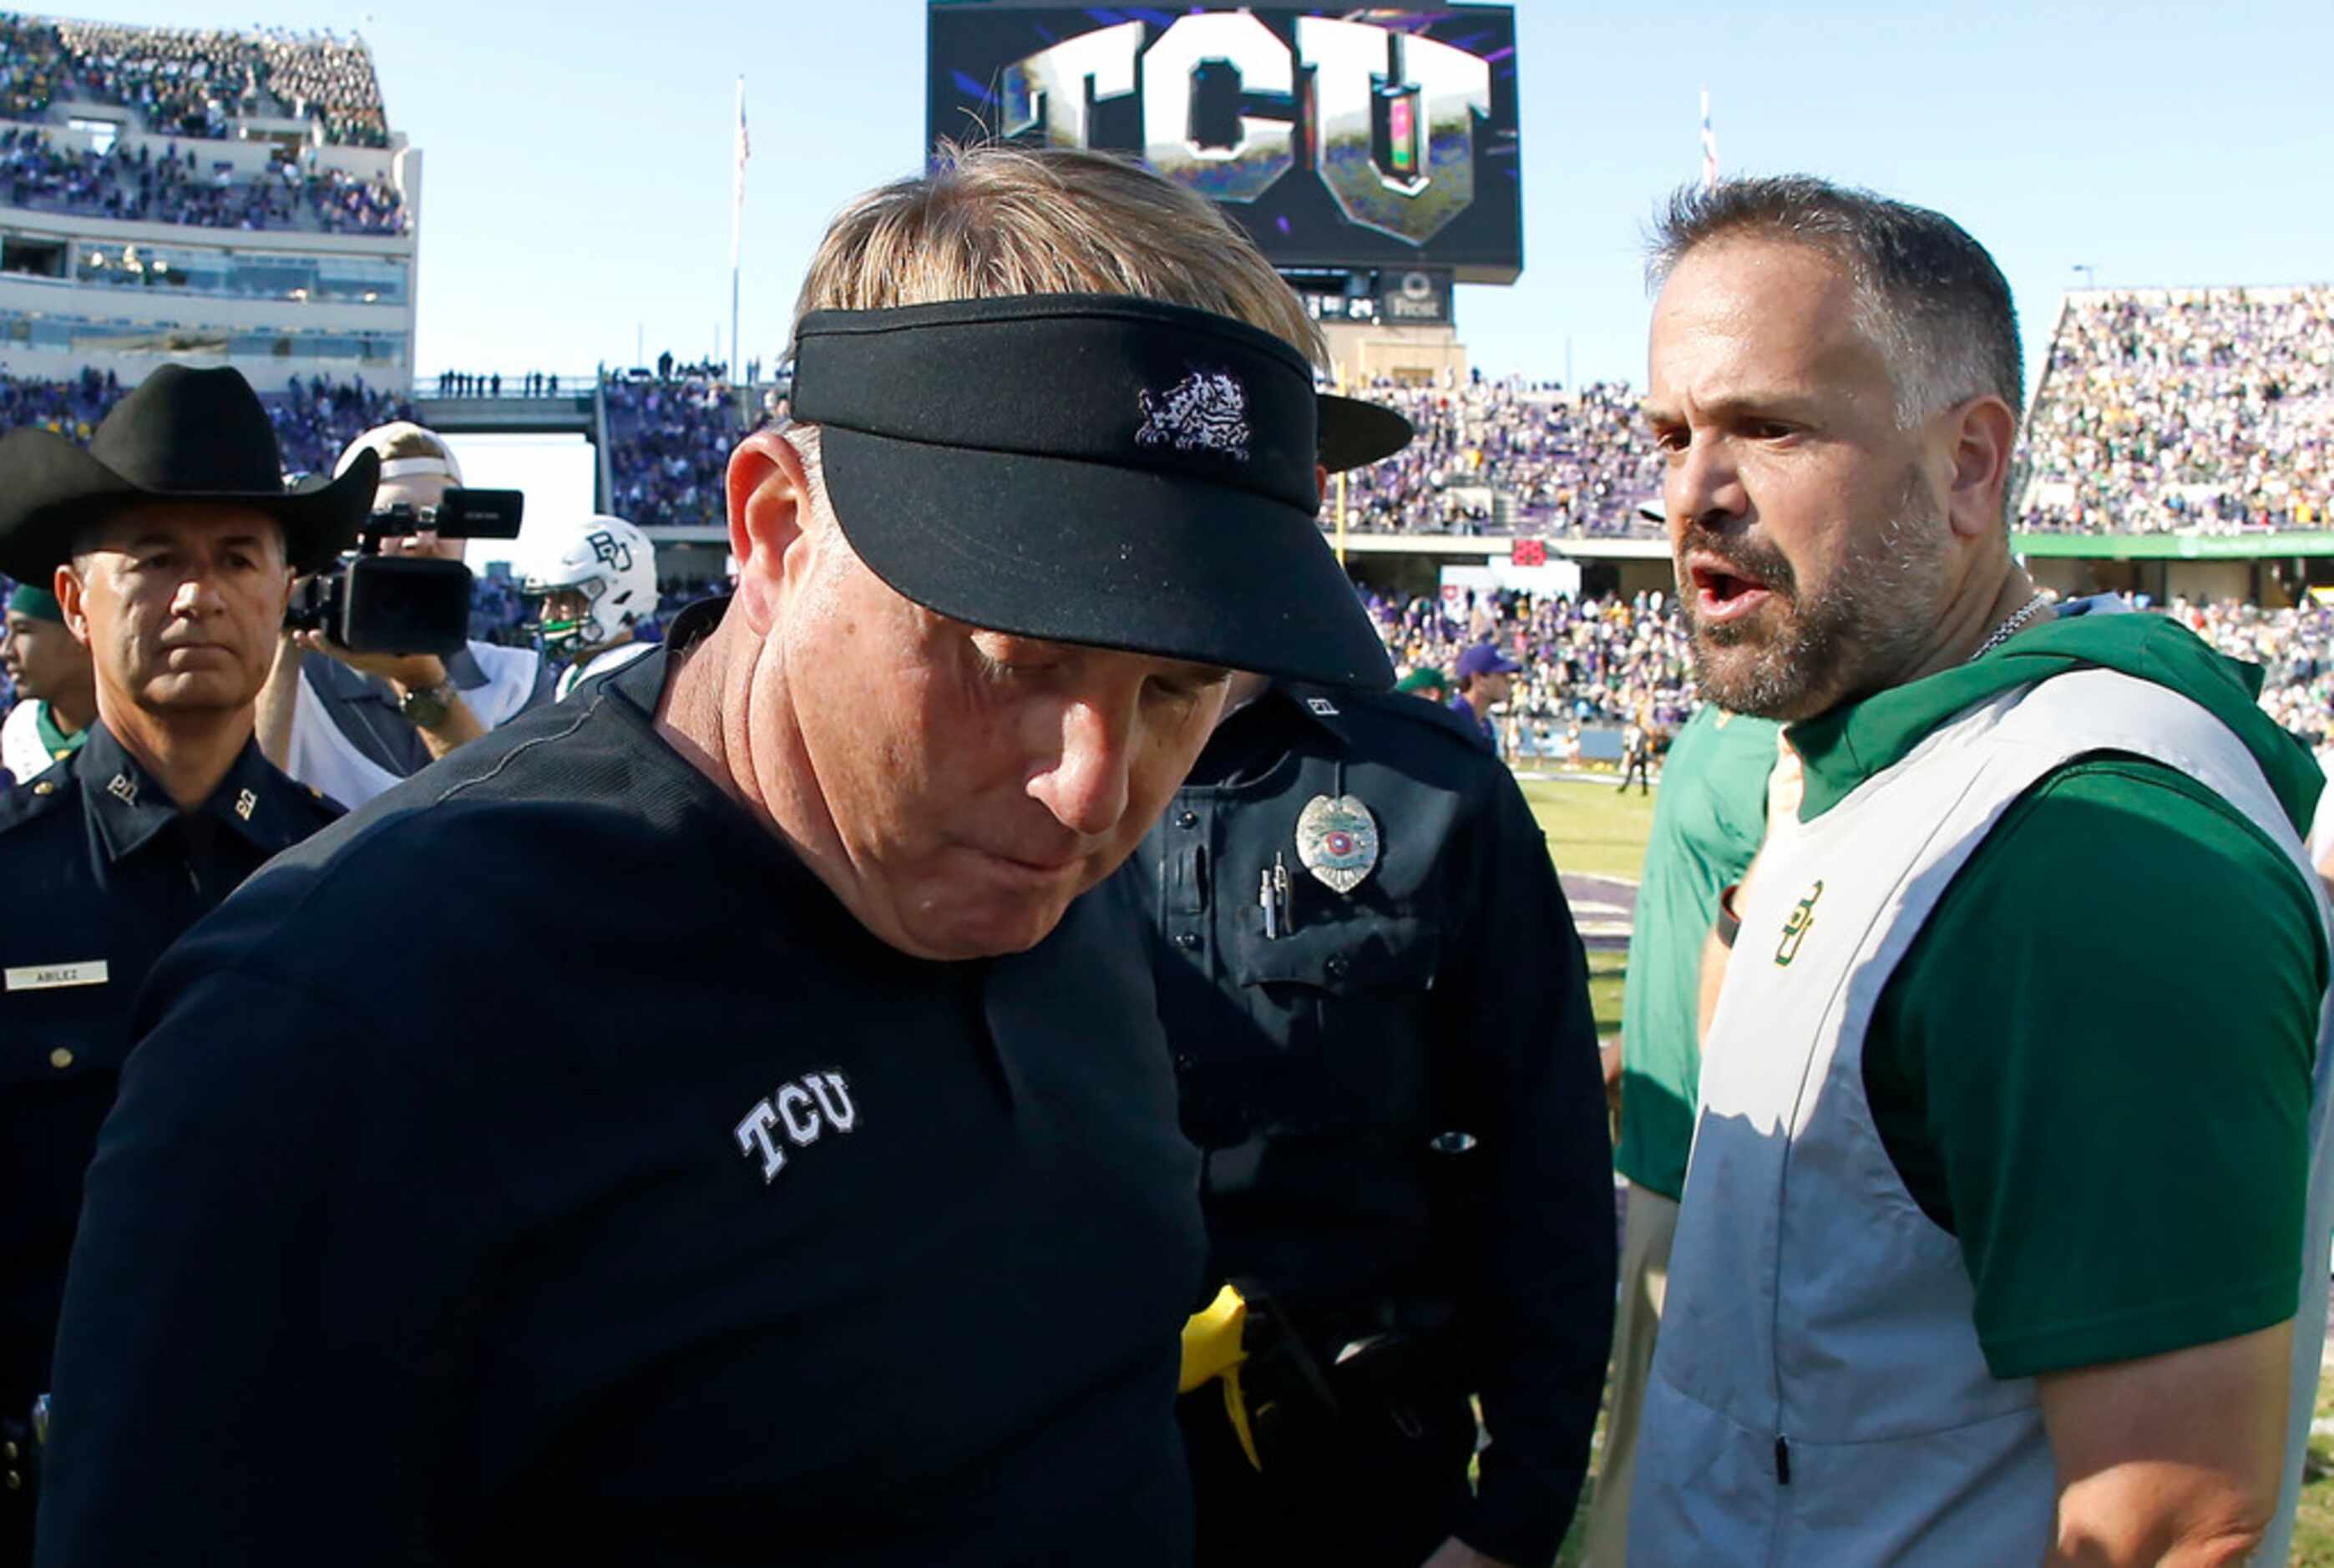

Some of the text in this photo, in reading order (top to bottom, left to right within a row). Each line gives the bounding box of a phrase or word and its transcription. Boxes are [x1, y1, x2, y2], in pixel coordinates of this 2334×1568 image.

[1003, 12, 1491, 246] TCU
[586, 530, 632, 572] BU
[734, 1067, 856, 1186] TCU
